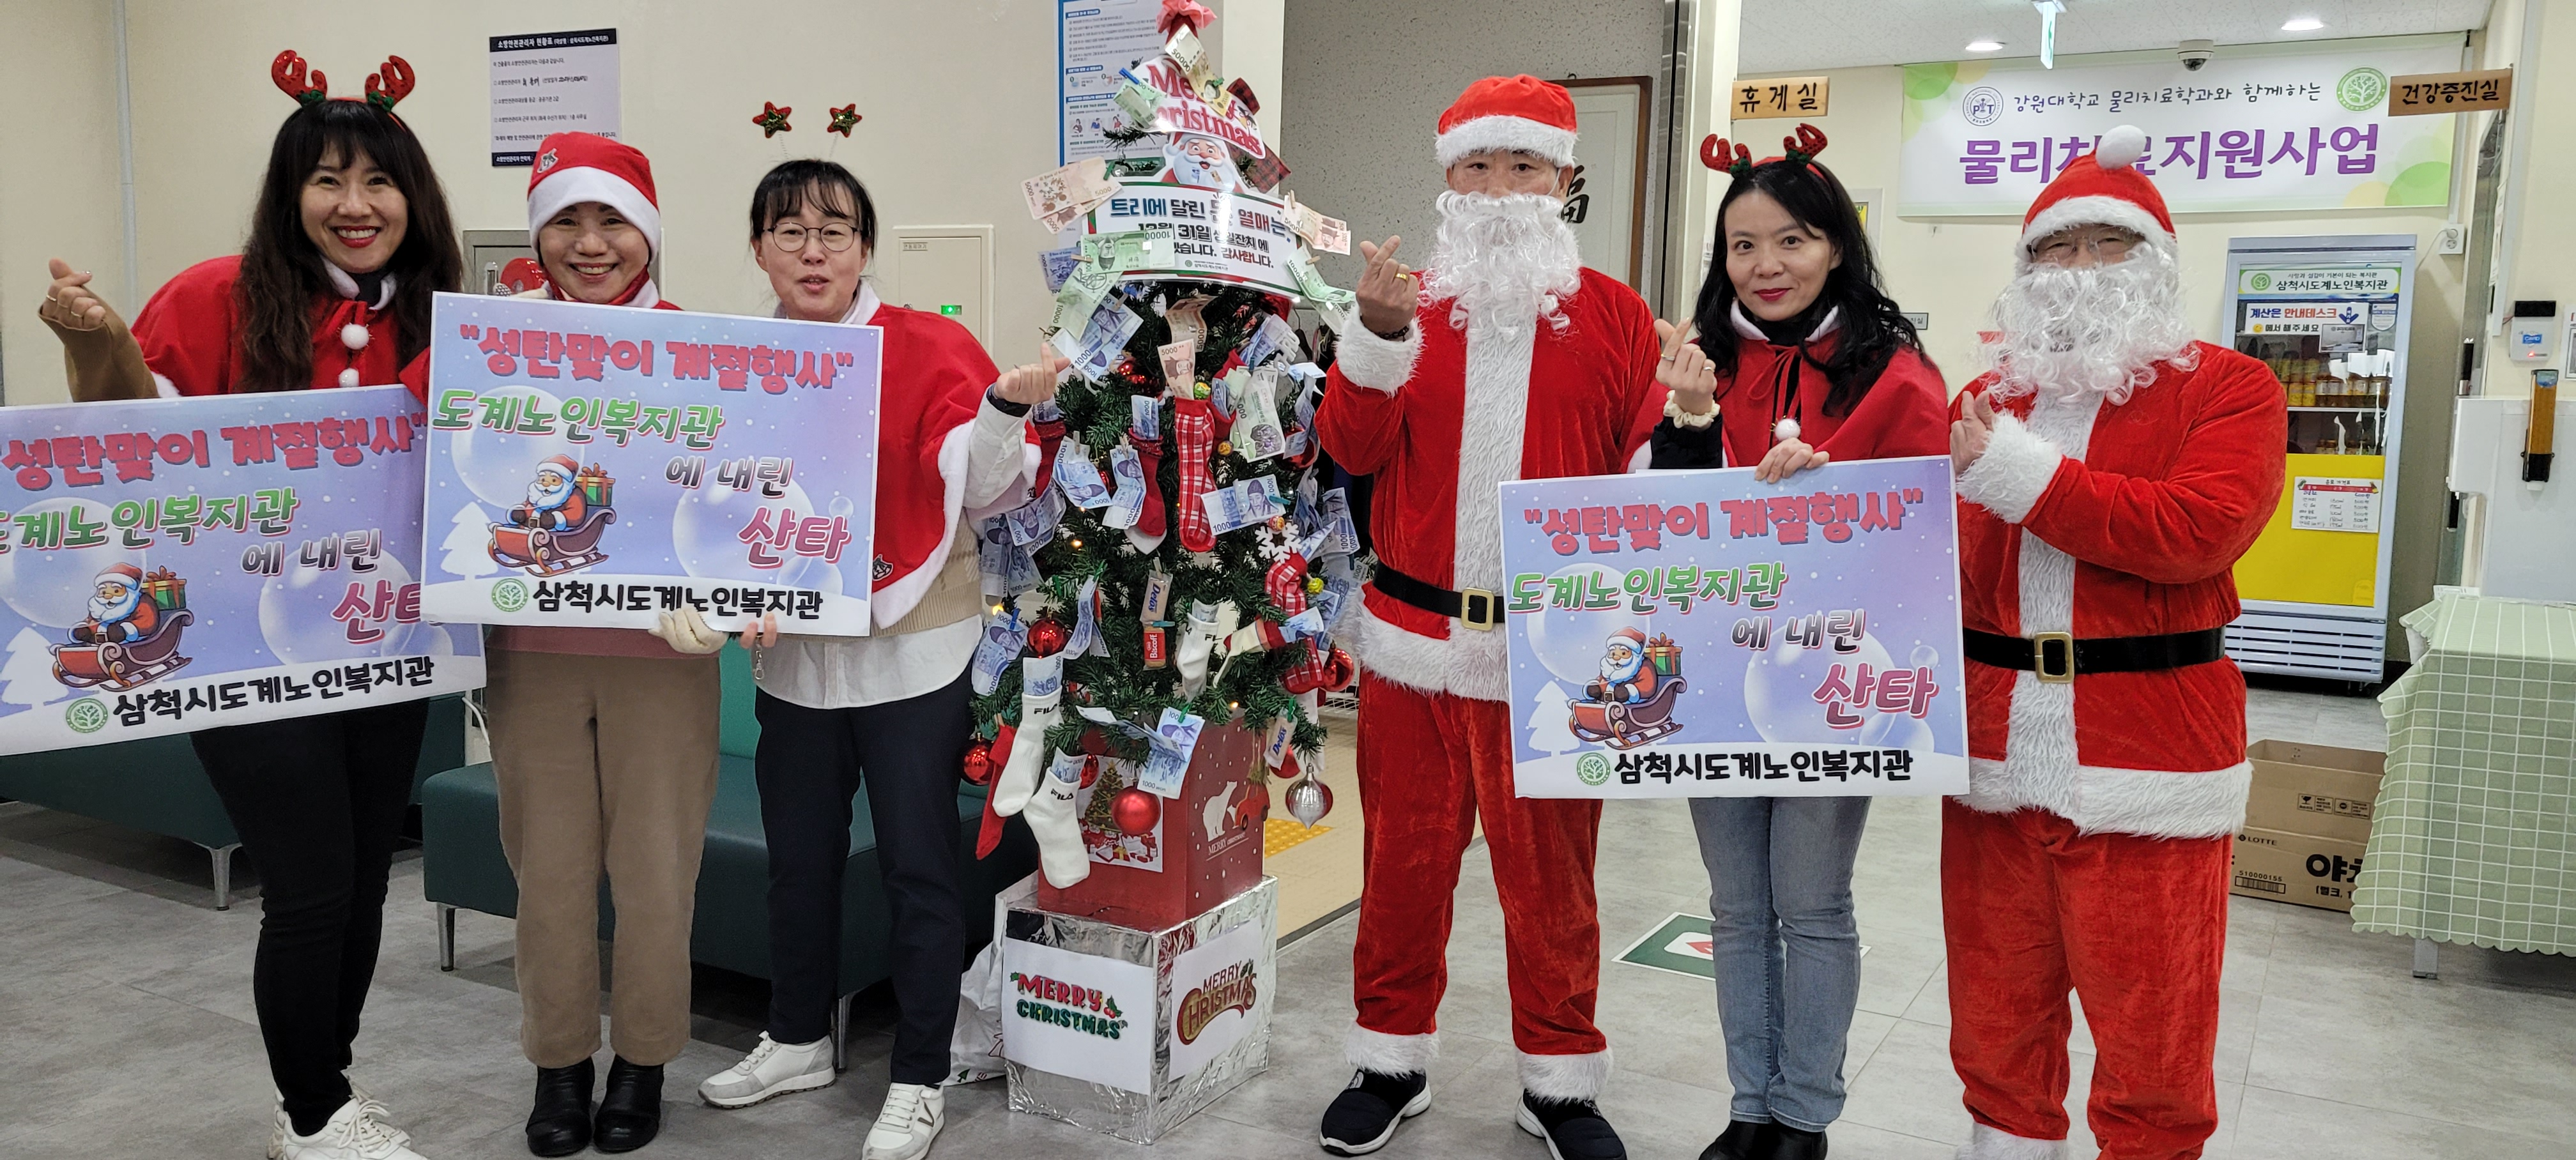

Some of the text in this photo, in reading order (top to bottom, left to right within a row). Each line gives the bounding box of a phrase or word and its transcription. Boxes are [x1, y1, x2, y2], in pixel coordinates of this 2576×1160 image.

[1172, 48, 1191, 72] 50000
[1740, 82, 1818, 113] 휴게실
[2014, 82, 2321, 113] 강원대학교 물리치료학과와 함께하는
[2402, 79, 2499, 105] 건강증진실
[1025, 181, 1034, 196] 5000
[1094, 186, 1112, 196] 5000
[1046, 217, 1060, 232] 5000
[1110, 198, 1167, 218] 트리에
[1170, 199, 1206, 220] 달린
[1238, 209, 1287, 237] 열매는
[1284, 217, 1300, 233] 5000
[1145, 231, 1171, 240] 10000
[1178, 224, 1211, 241] 31일
[1258, 239, 1269, 253] 에
[1222, 247, 1274, 268] 감사합니다.
[1289, 259, 1303, 283] 10000
[2276, 280, 2388, 291] 삼척시도계노인복지관
[1054, 304, 1064, 324] 10000
[2250, 308, 2281, 319] 계산은
[2266, 324, 2281, 332] 에서
[1197, 329, 1206, 350] 5000
[460, 324, 854, 394] "성탄맞이 계절행사"
[1075, 349, 1092, 367] 1000
[1161, 347, 1178, 356] 5000
[1084, 365, 1098, 378] 1000
[432, 390, 725, 449] 도계노인복지관
[0, 412, 428, 491] 성탄맞이 계절행사"
[1058, 444, 1067, 464] 1000
[665, 456, 794, 498] 에 내린
[1266, 478, 1275, 492] 1000
[1124, 508, 1136, 527] 1000
[1213, 521, 1232, 533] 1000
[1524, 488, 1923, 556] "성탄맞이 계절행사"
[737, 507, 853, 569] 산타
[1015, 530, 1023, 544] 1000
[1029, 538, 1044, 554] 1000
[1349, 535, 1358, 551] 1000
[242, 529, 383, 576] 에 내린
[1508, 561, 1789, 614] 도계노인복지관
[533, 581, 824, 618] 삼척시도계노인복지관
[1148, 583, 1162, 614] Delos
[997, 614, 1011, 625] 1000
[1731, 607, 1866, 653] 에 내린
[113, 657, 434, 728] 삼척시도계노인복지관
[1813, 662, 1940, 729] 산타
[1169, 711, 1179, 720] 100
[1273, 726, 1287, 756] Delos
[1614, 749, 1913, 784] 삼척시도계노인복지관
[1050, 789, 1074, 800] FILA
[1142, 780, 1156, 790] 1000
[1208, 838, 1227, 855] MERRY
[2248, 836, 2277, 846] LOTTE
[2239, 870, 2282, 882] 510000155
[1203, 960, 1242, 995] MERRY
[1018, 973, 1103, 1012] MERRY
[1016, 998, 1121, 1040] CHRISTMAS
[1177, 973, 1257, 1046] CHRISTMAS
